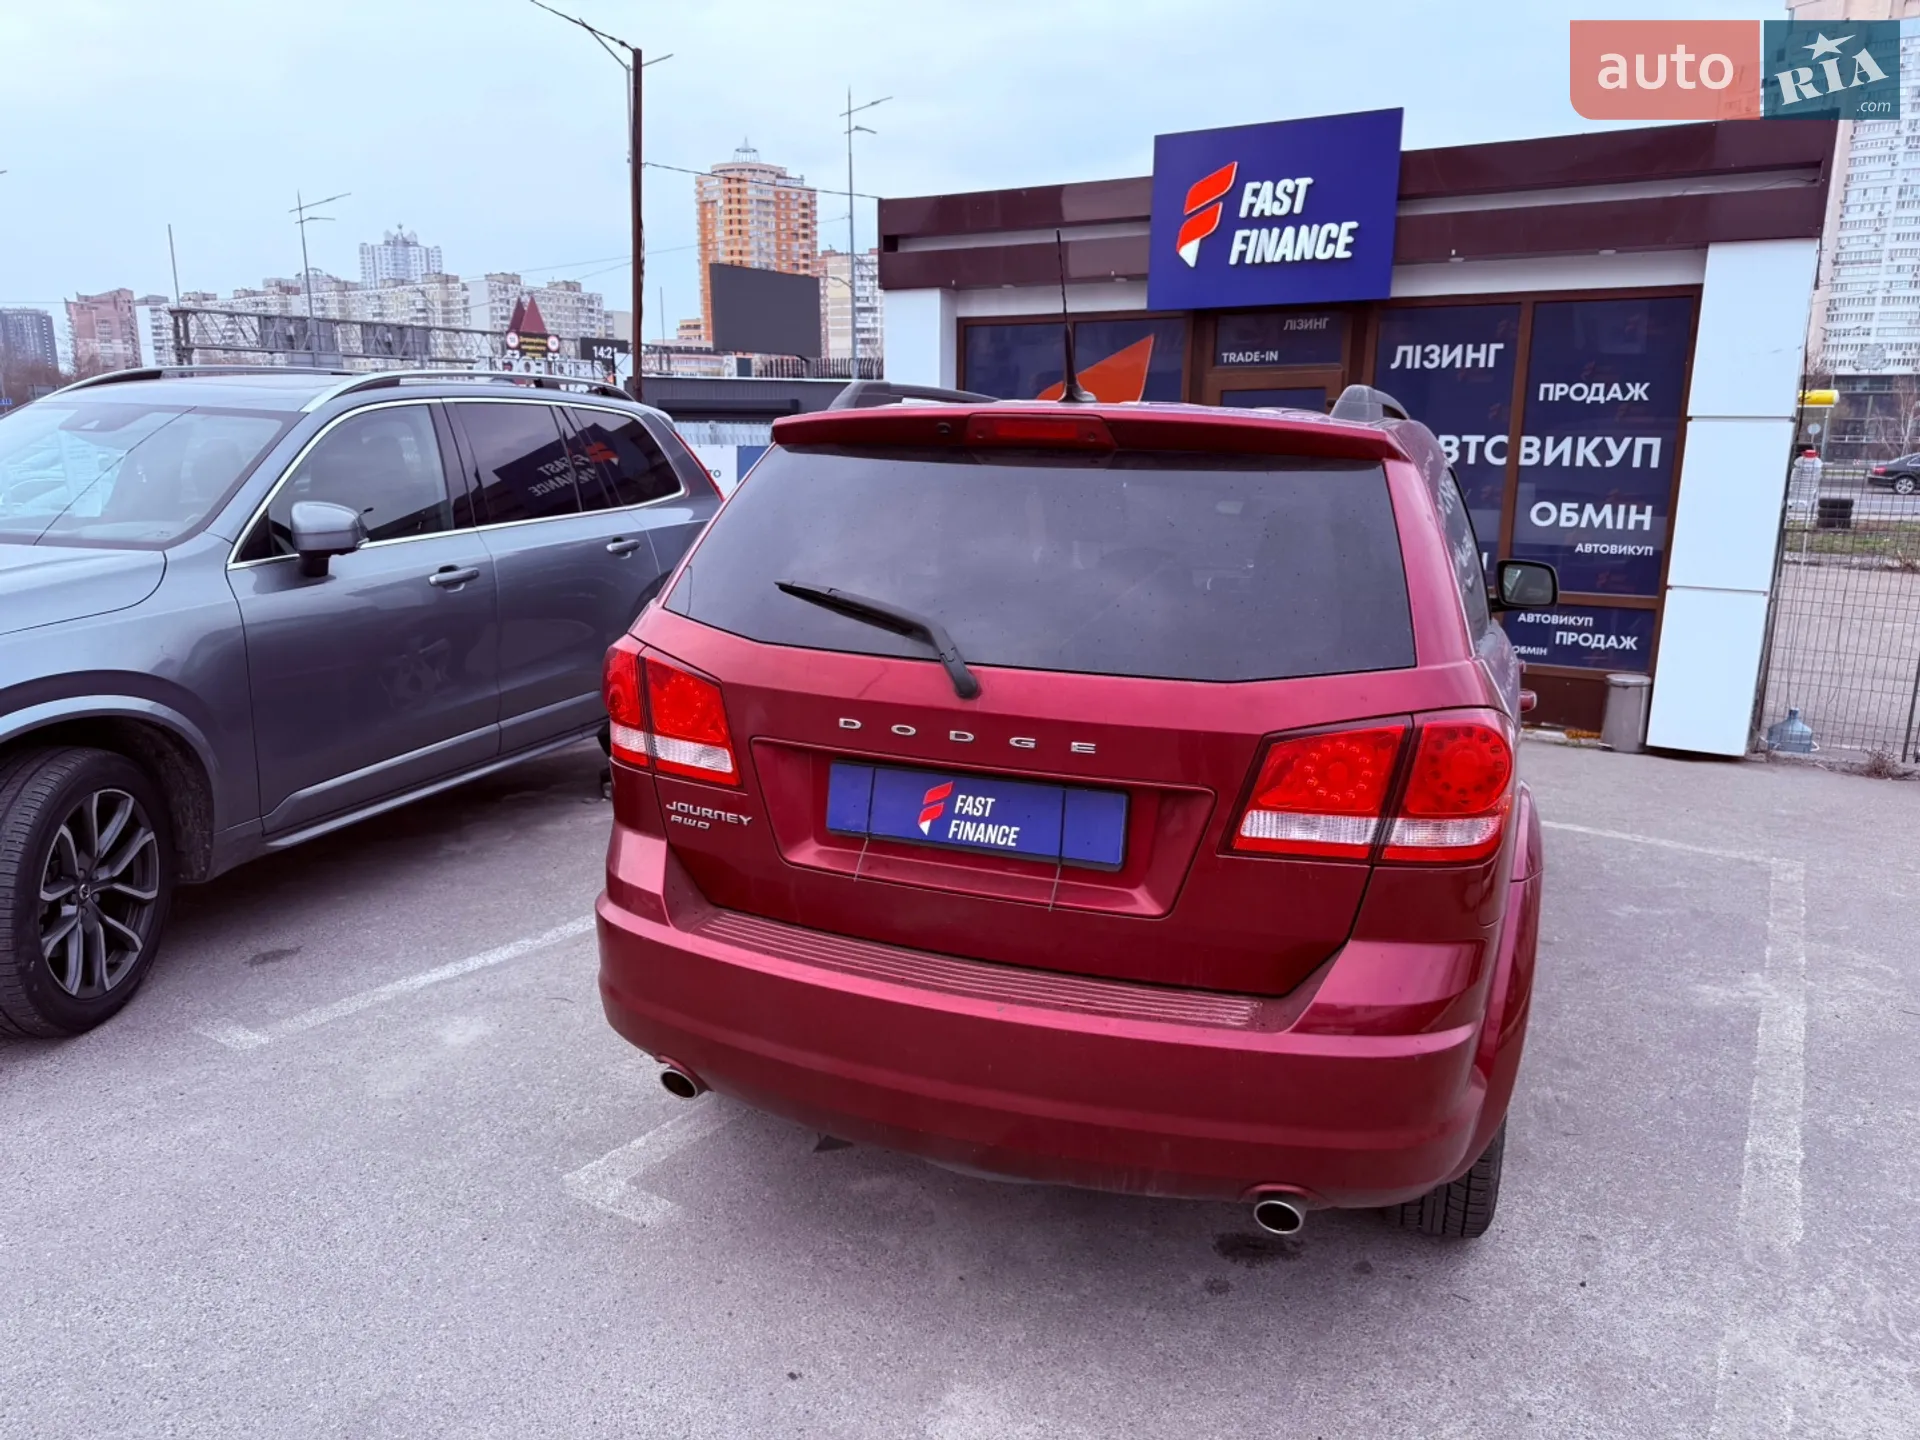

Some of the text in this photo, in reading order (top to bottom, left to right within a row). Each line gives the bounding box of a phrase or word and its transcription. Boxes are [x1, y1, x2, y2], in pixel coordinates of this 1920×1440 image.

[1239, 177, 1313, 218] FAST
[1228, 221, 1358, 265] FINANCE
[1283, 317, 1330, 330] ЛІЗИНГ
[1221, 351, 1279, 363] TRADE-IN
[1390, 343, 1504, 369] ЛІЗИНГ
[1539, 383, 1651, 404] ПРОДАЖ
[1437, 435, 1661, 468] ВТОВИКУП
[1529, 501, 1653, 531] ОБМІН
[1574, 543, 1653, 556] АВТОВИКУП
[1517, 612, 1594, 627] АВТОВИКУП
[1555, 631, 1638, 650] ПРОДАЖ
[838, 717, 1096, 754] DODGE
[665, 801, 752, 826] JOURNEY
[954, 794, 996, 817] FAST
[670, 815, 710, 830] AWD
[948, 820, 1020, 847] FINANCE
